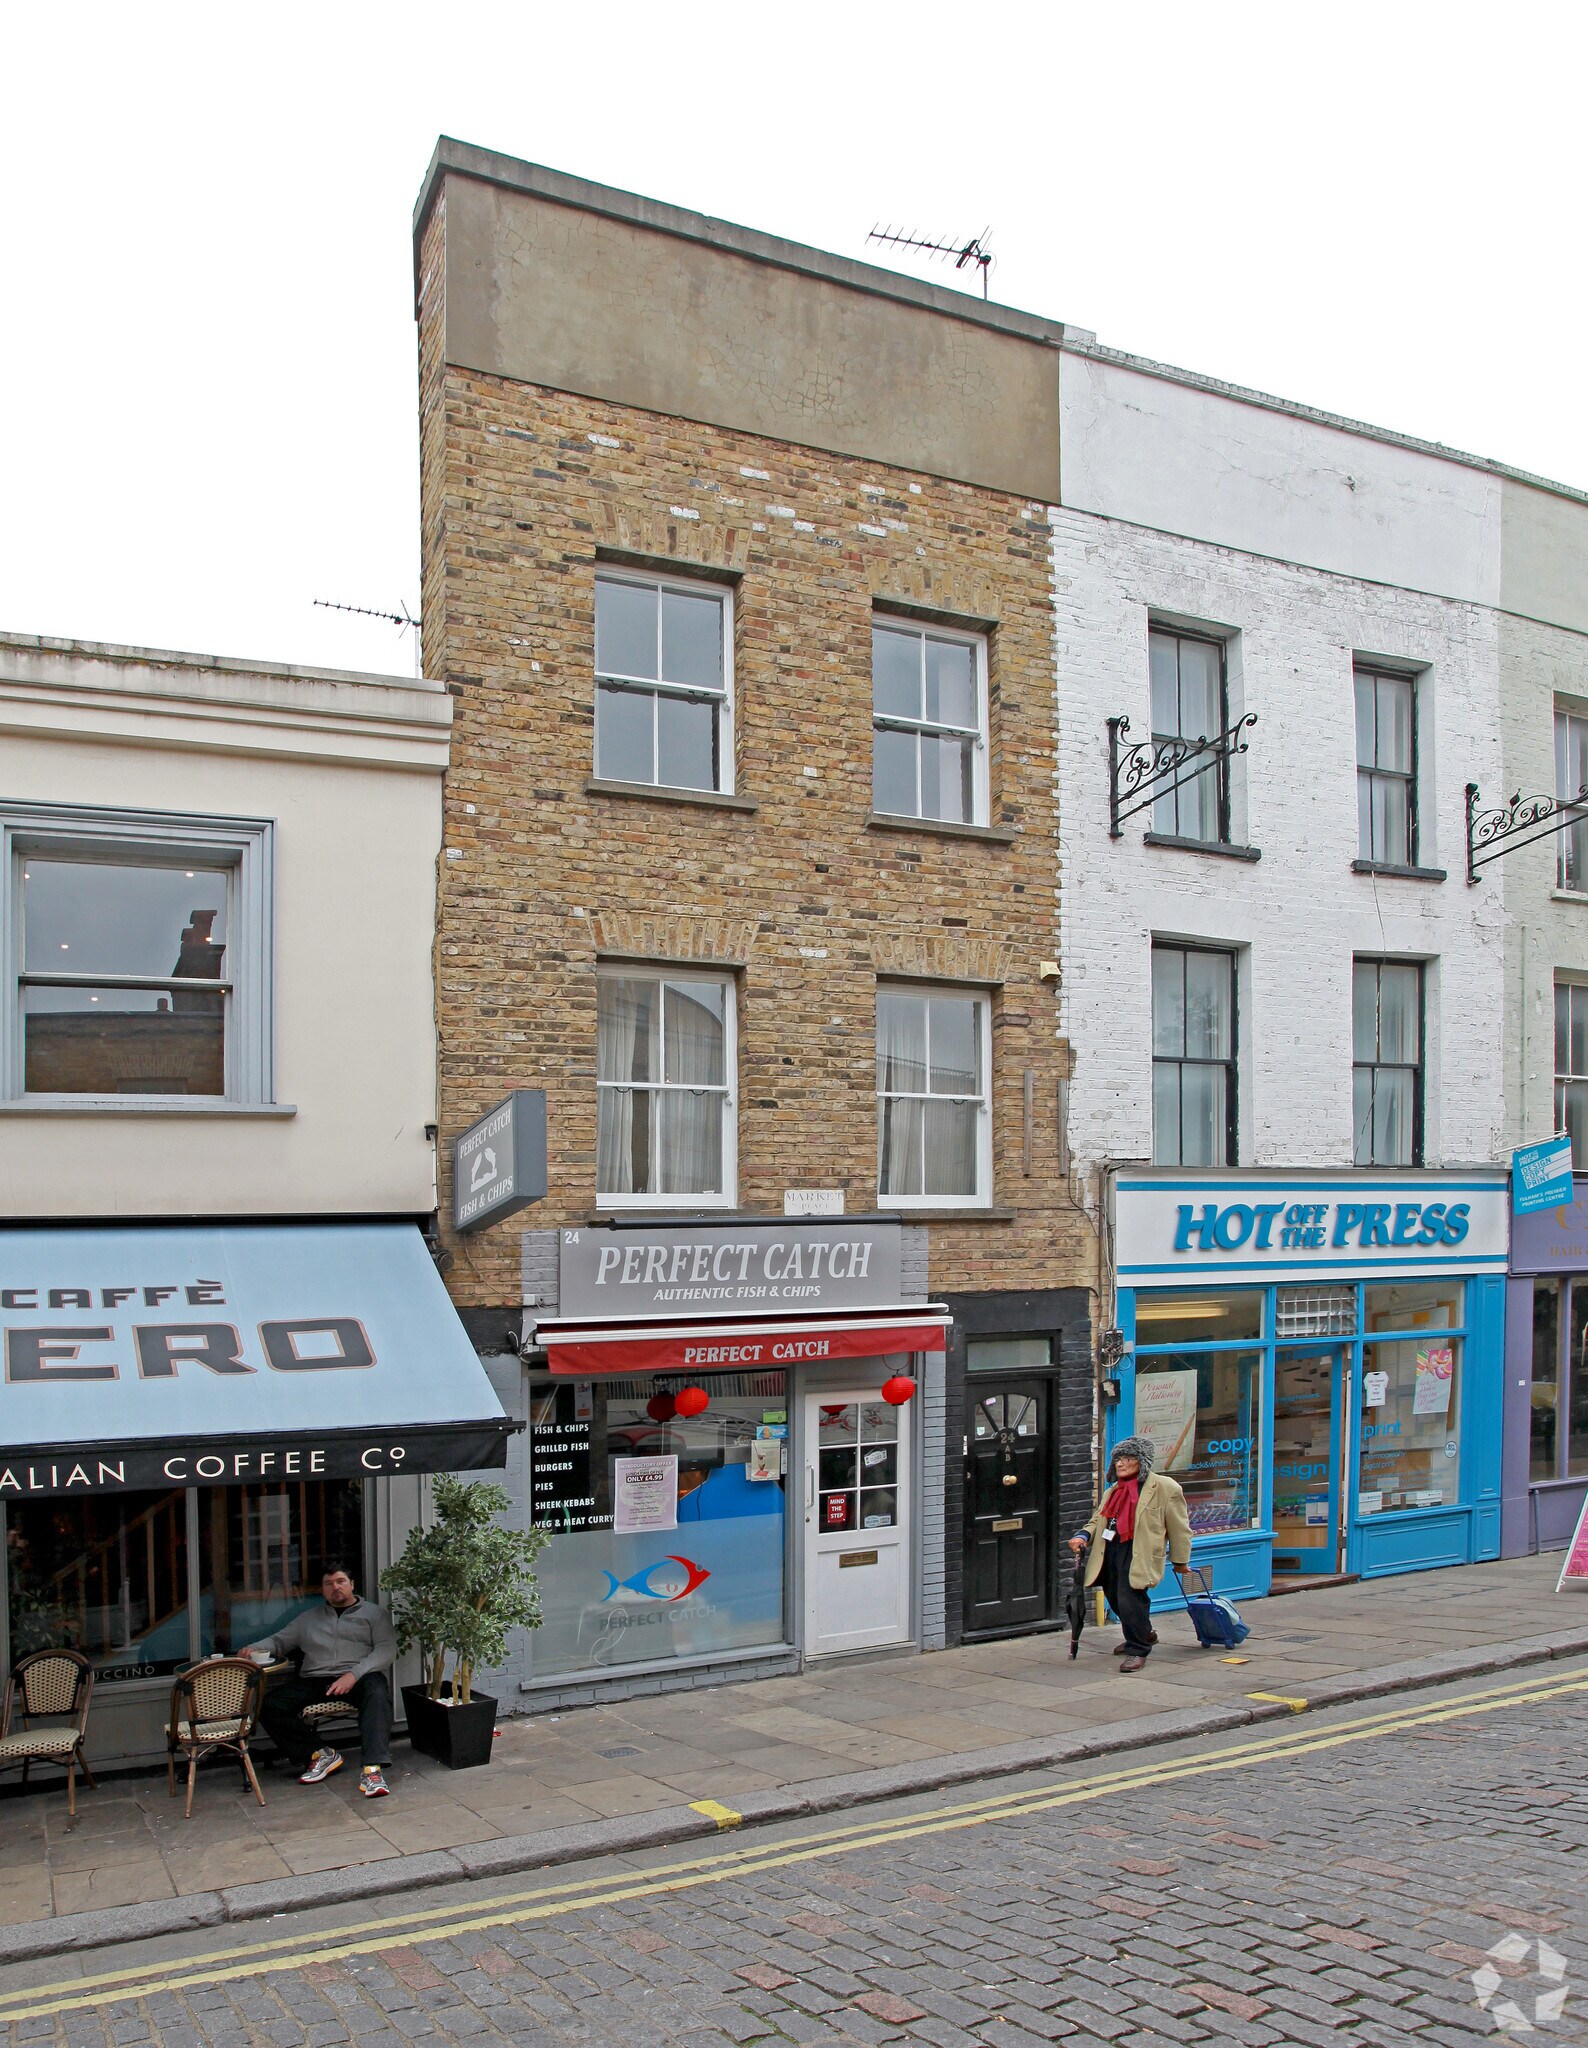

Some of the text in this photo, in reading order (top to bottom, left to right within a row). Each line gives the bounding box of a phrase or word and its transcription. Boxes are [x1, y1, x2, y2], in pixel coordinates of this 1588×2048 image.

[460, 1108, 511, 1159] PERFECT CATCH
[1522, 1157, 1551, 1174] DESIGN
[1524, 1167, 1545, 1181] COPY
[1527, 1172, 1550, 1189] PRINT
[460, 1176, 513, 1220] FISH & CHIPS
[1522, 1193, 1565, 1207] PRINTING CENTRE
[1285, 1203, 1329, 1225] OFF
[1174, 1201, 1287, 1250] HOT
[1332, 1202, 1471, 1247] PRESS
[565, 1231, 580, 1244] 24
[1280, 1226, 1327, 1248] THE
[595, 1242, 873, 1285] PERFECT CATCH
[1, 1279, 228, 1309] CAFFÈ
[653, 1285, 821, 1301] AUTHENTIC FISH & CHIPS
[684, 1340, 830, 1363] PERFECT CATCH
[534, 1424, 589, 1434] FISH & CHIPS
[1363, 1420, 1402, 1440] print
[1000, 1433, 1015, 1444] 24
[1207, 1437, 1255, 1455] copy
[534, 1442, 589, 1453] GRILLED FISH
[1005, 1445, 1010, 1453] A
[163, 1450, 325, 1480] COFFEE
[1006, 1453, 1011, 1462] B
[534, 1462, 573, 1473] BURGERS
[535, 1482, 554, 1491] PIES
[627, 1475, 644, 1483] ONLY
[535, 1498, 595, 1510] SHEEK KEBABS
[534, 1515, 615, 1529] VEG & MEAT CURRY
[599, 1605, 716, 1630] PERFECT CATCH
